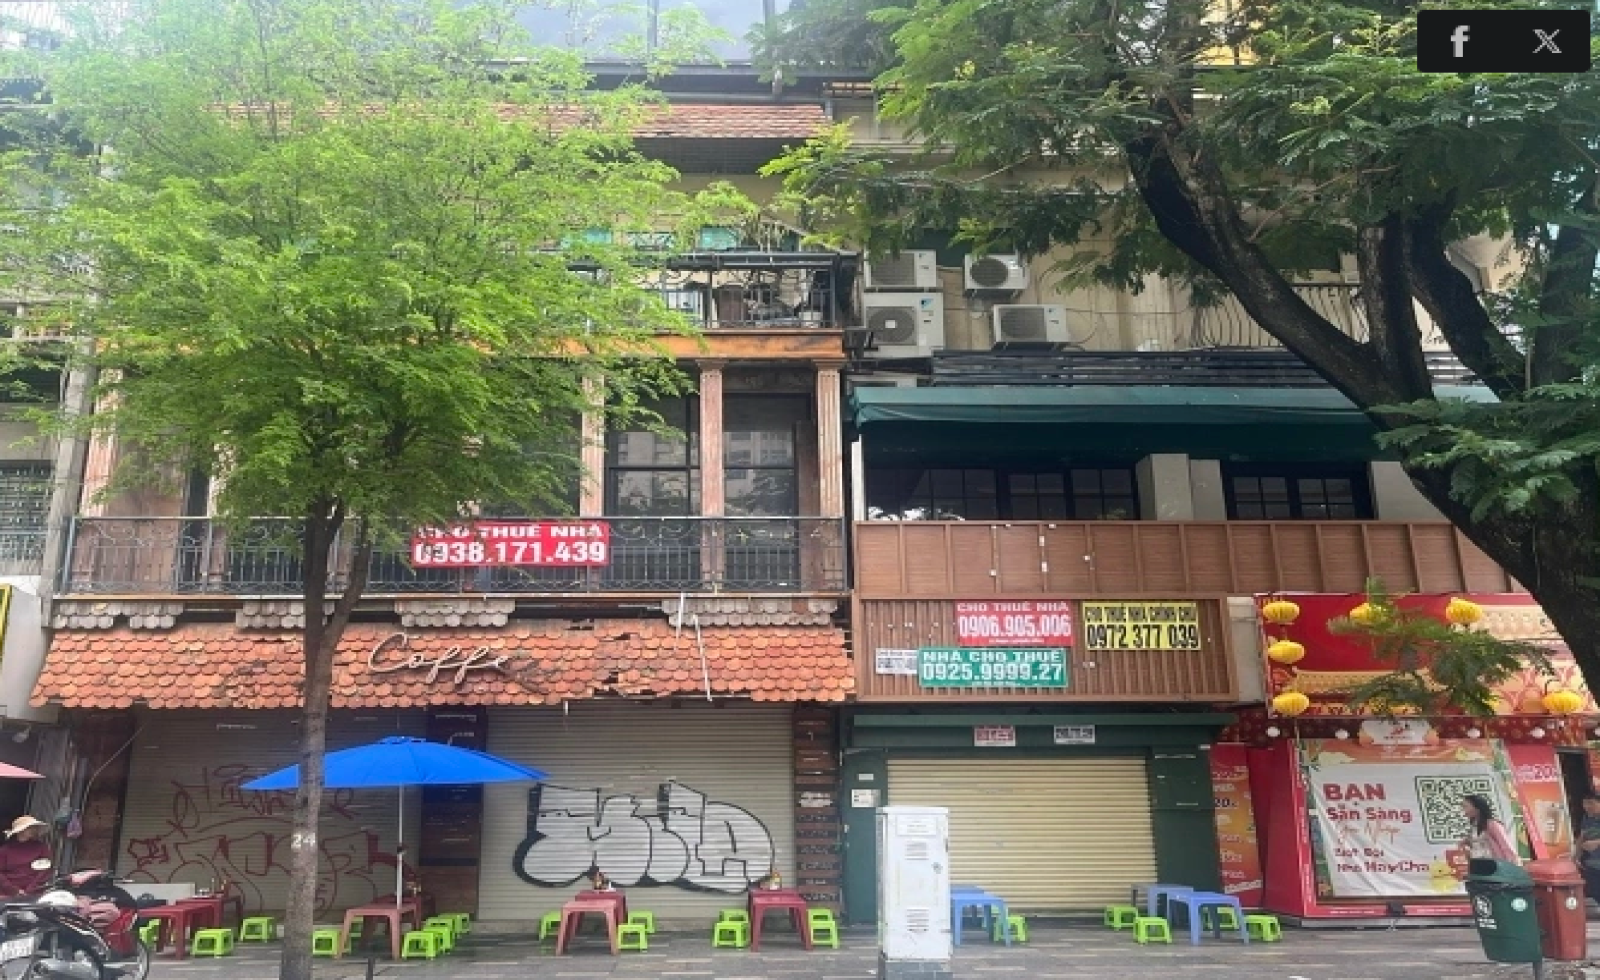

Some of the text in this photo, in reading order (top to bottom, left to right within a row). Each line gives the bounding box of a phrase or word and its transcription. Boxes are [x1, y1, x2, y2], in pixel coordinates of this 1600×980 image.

[414, 541, 605, 564] 0938.171.439
[959, 615, 1071, 637] 0906.905.006
[1087, 624, 1199, 648] 0972 377 039
[969, 651, 1007, 662] CHO
[923, 663, 1062, 680] 0925.9999.27
